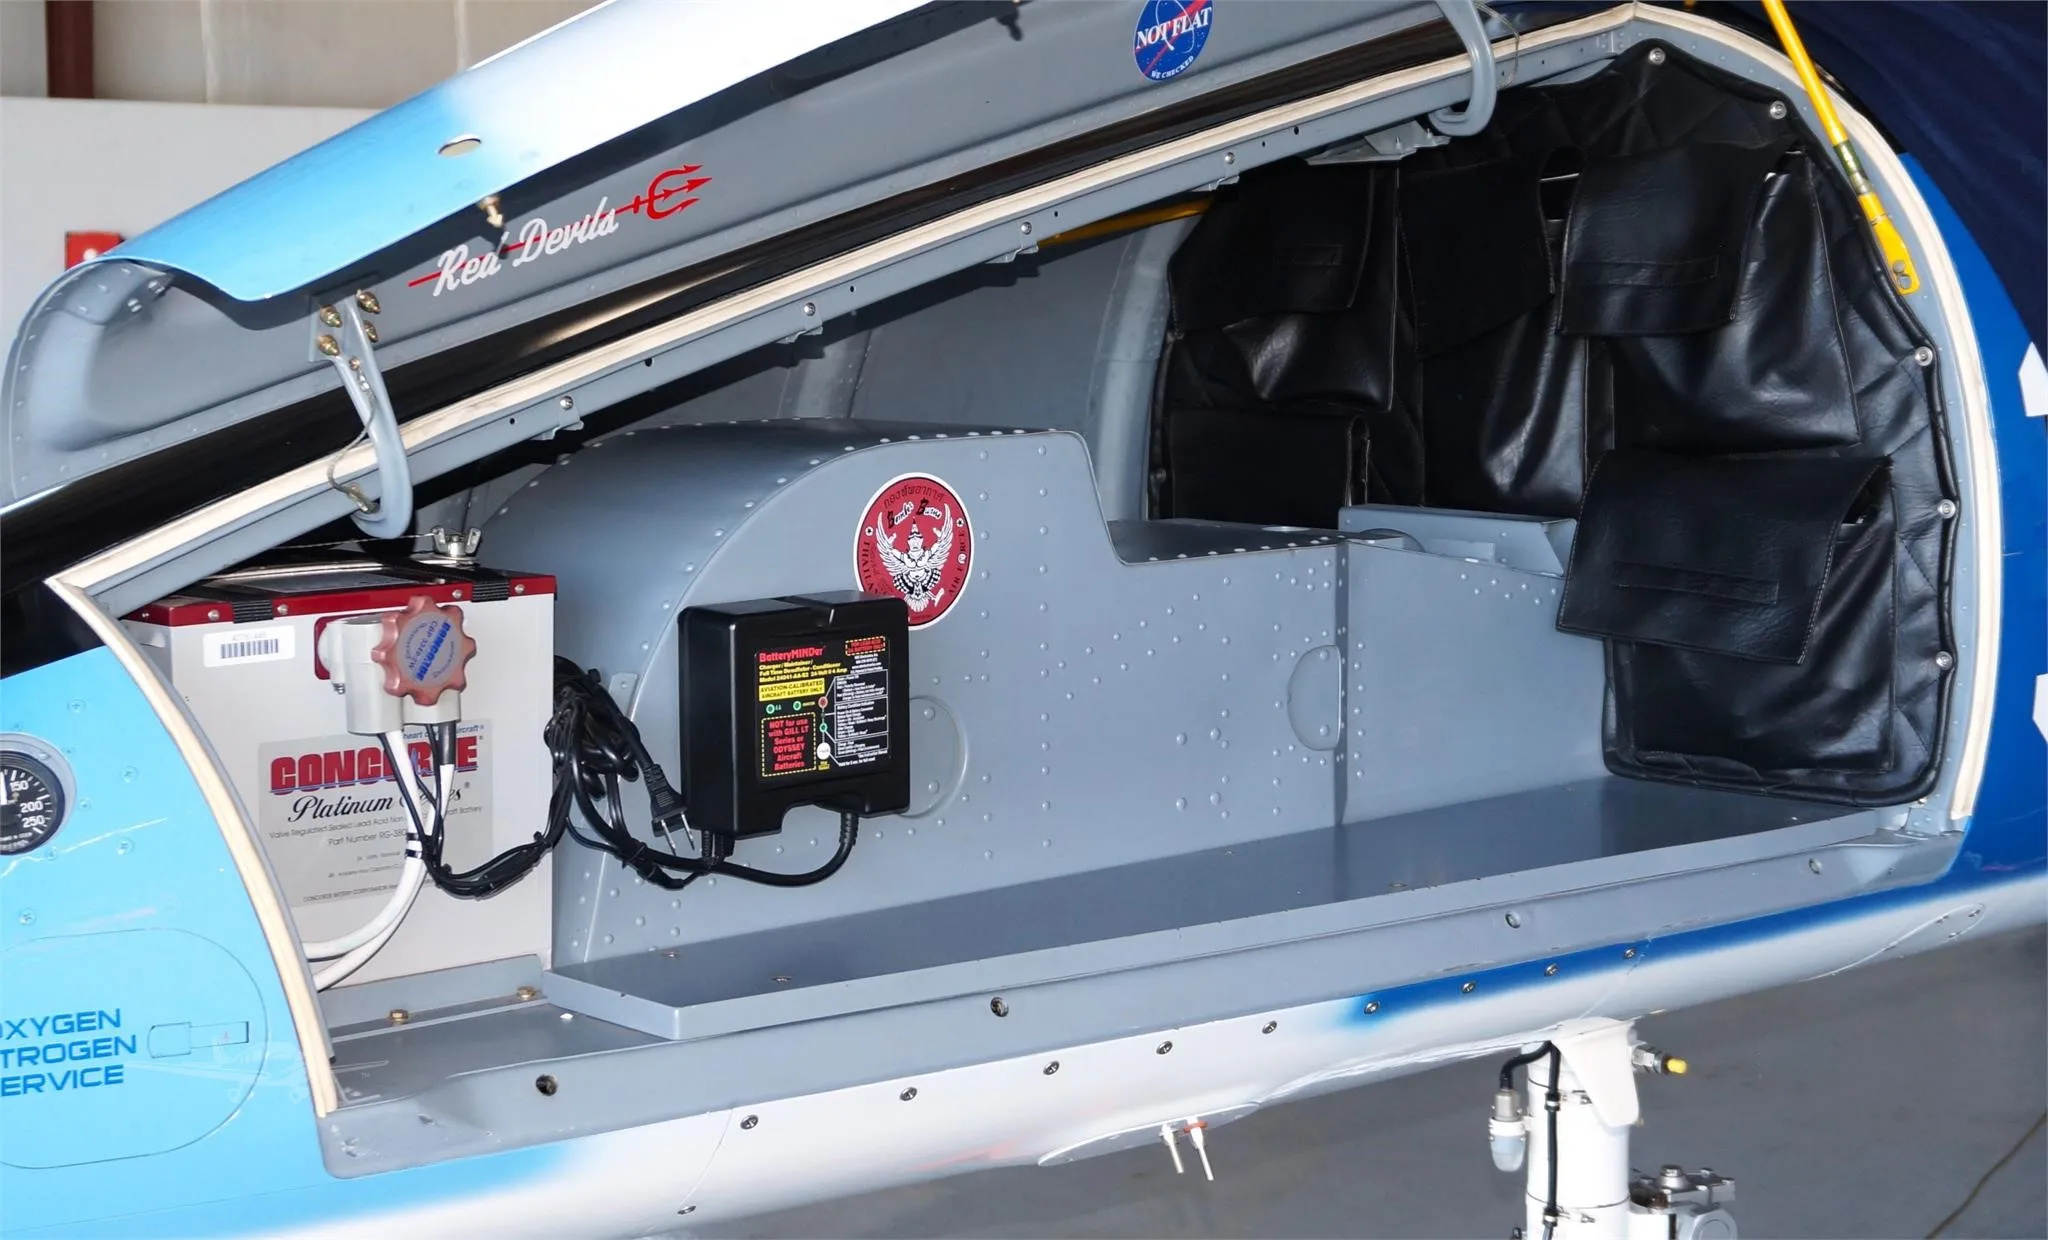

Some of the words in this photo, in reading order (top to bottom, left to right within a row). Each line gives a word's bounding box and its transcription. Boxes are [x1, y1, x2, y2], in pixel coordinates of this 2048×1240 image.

[1136, 22, 1171, 49] NOT
[1172, 7, 1212, 37] FLAT
[1161, 55, 1194, 78] CHECKED
[433, 232, 508, 296] Red
[513, 196, 620, 267] Devils
[759, 647, 823, 663] BatteryMINDer
[762, 690, 786, 698] AIRCRAFT
[769, 720, 784, 729] NOT
[785, 719, 795, 727] for
[769, 729, 783, 737] with
[784, 726, 799, 735] GILL
[801, 725, 809, 733] LT
[774, 737, 795, 745] Series
[773, 743, 805, 754] ODYSSEY
[777, 752, 802, 762] Aircraft
[270, 736, 478, 795] CONCRE
[774, 761, 805, 771] Batteries
[10, 780, 29, 793] 150
[20, 800, 44, 813] 200
[288, 795, 393, 822] Platinum
[22, 815, 45, 828] 250
[291, 826, 327, 836] Regulated
[328, 822, 352, 831] Sealed
[354, 819, 371, 828] Lead
[373, 818, 389, 826] Acid
[328, 836, 344, 846] Part
[345, 833, 377, 844] Number
[0, 1008, 121, 1040] XYGEN
[0, 1034, 137, 1069] TROGEN
[0, 1064, 125, 1097] ERVICE
